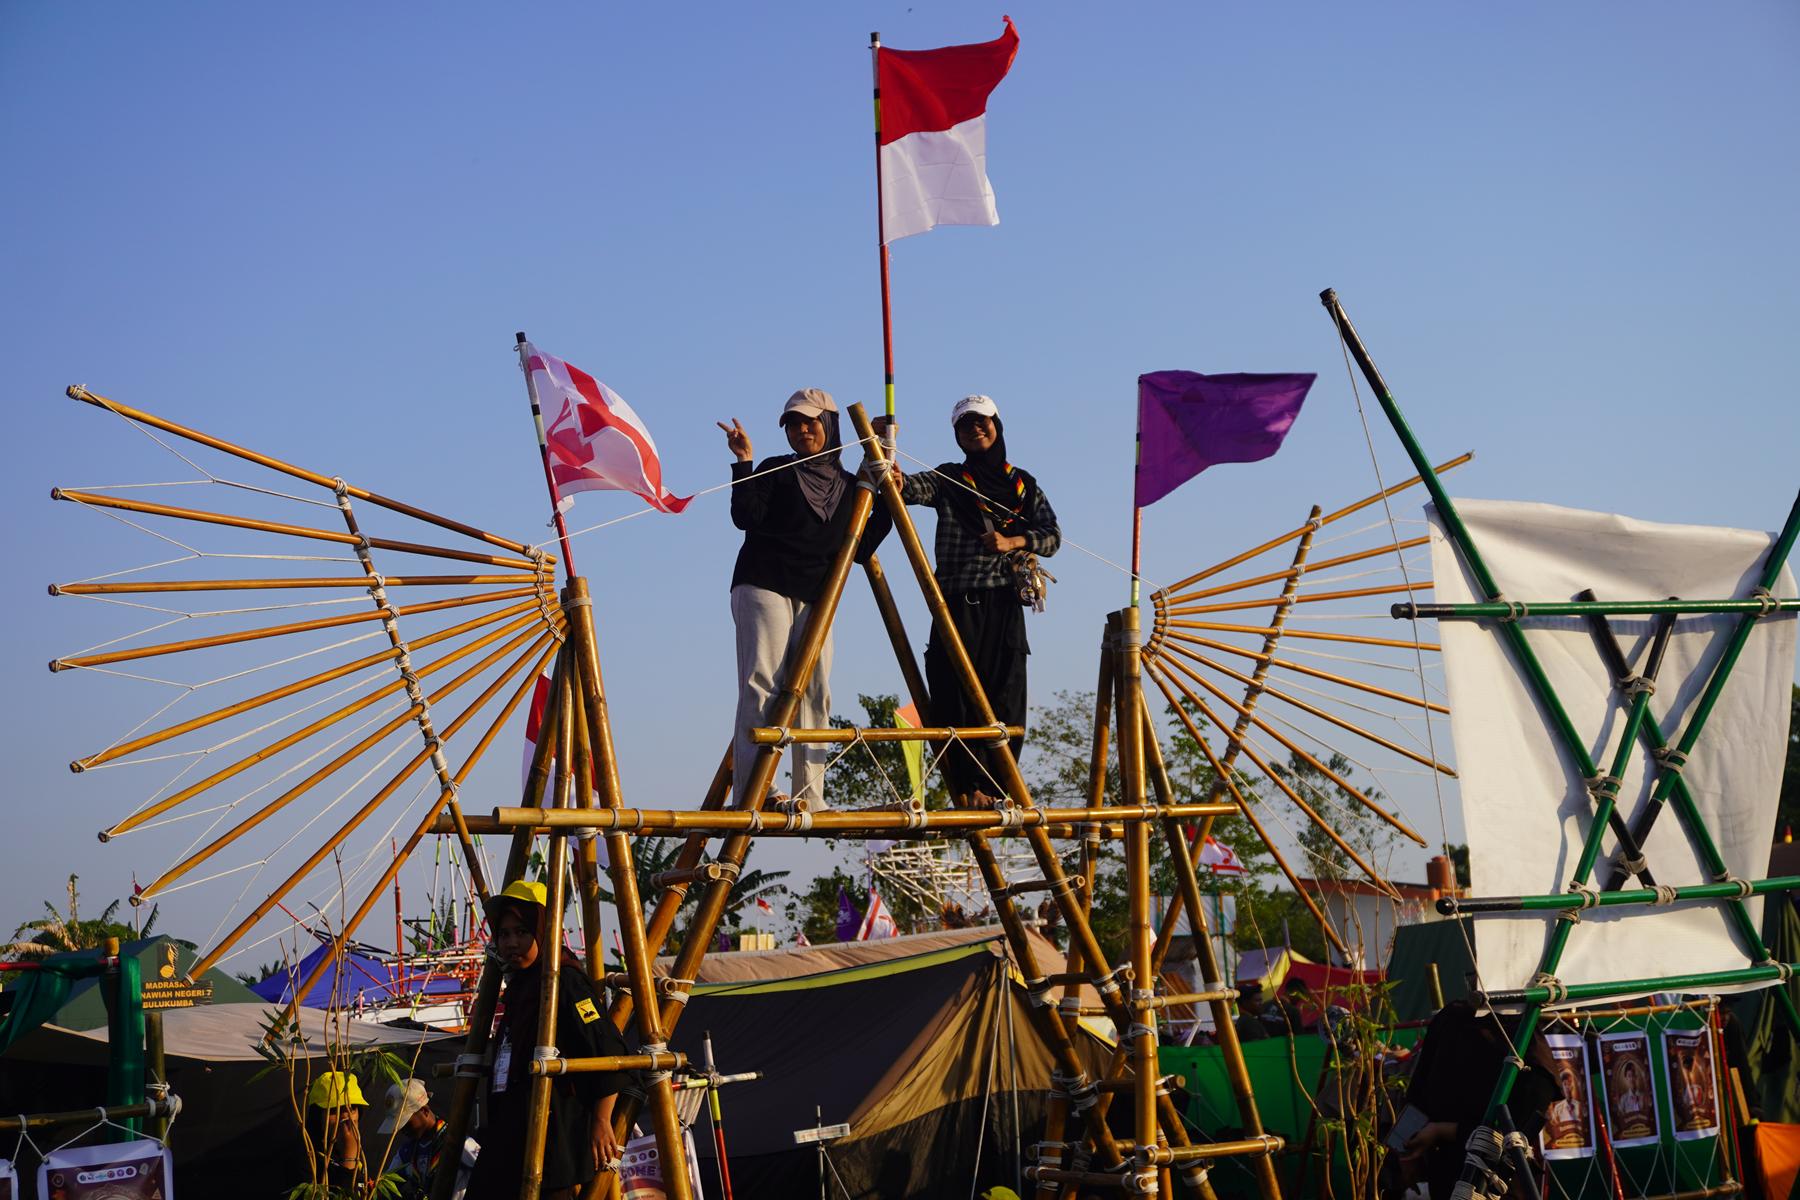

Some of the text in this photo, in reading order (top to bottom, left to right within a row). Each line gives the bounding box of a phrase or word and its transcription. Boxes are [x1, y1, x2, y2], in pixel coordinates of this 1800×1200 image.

[145, 982, 185, 990] MADRASA
[141, 991, 173, 1000] NAWIAH
[174, 989, 205, 998] NEGERI
[142, 999, 194, 1009] BULUKUMBA
[620, 1165, 657, 1179] COME
